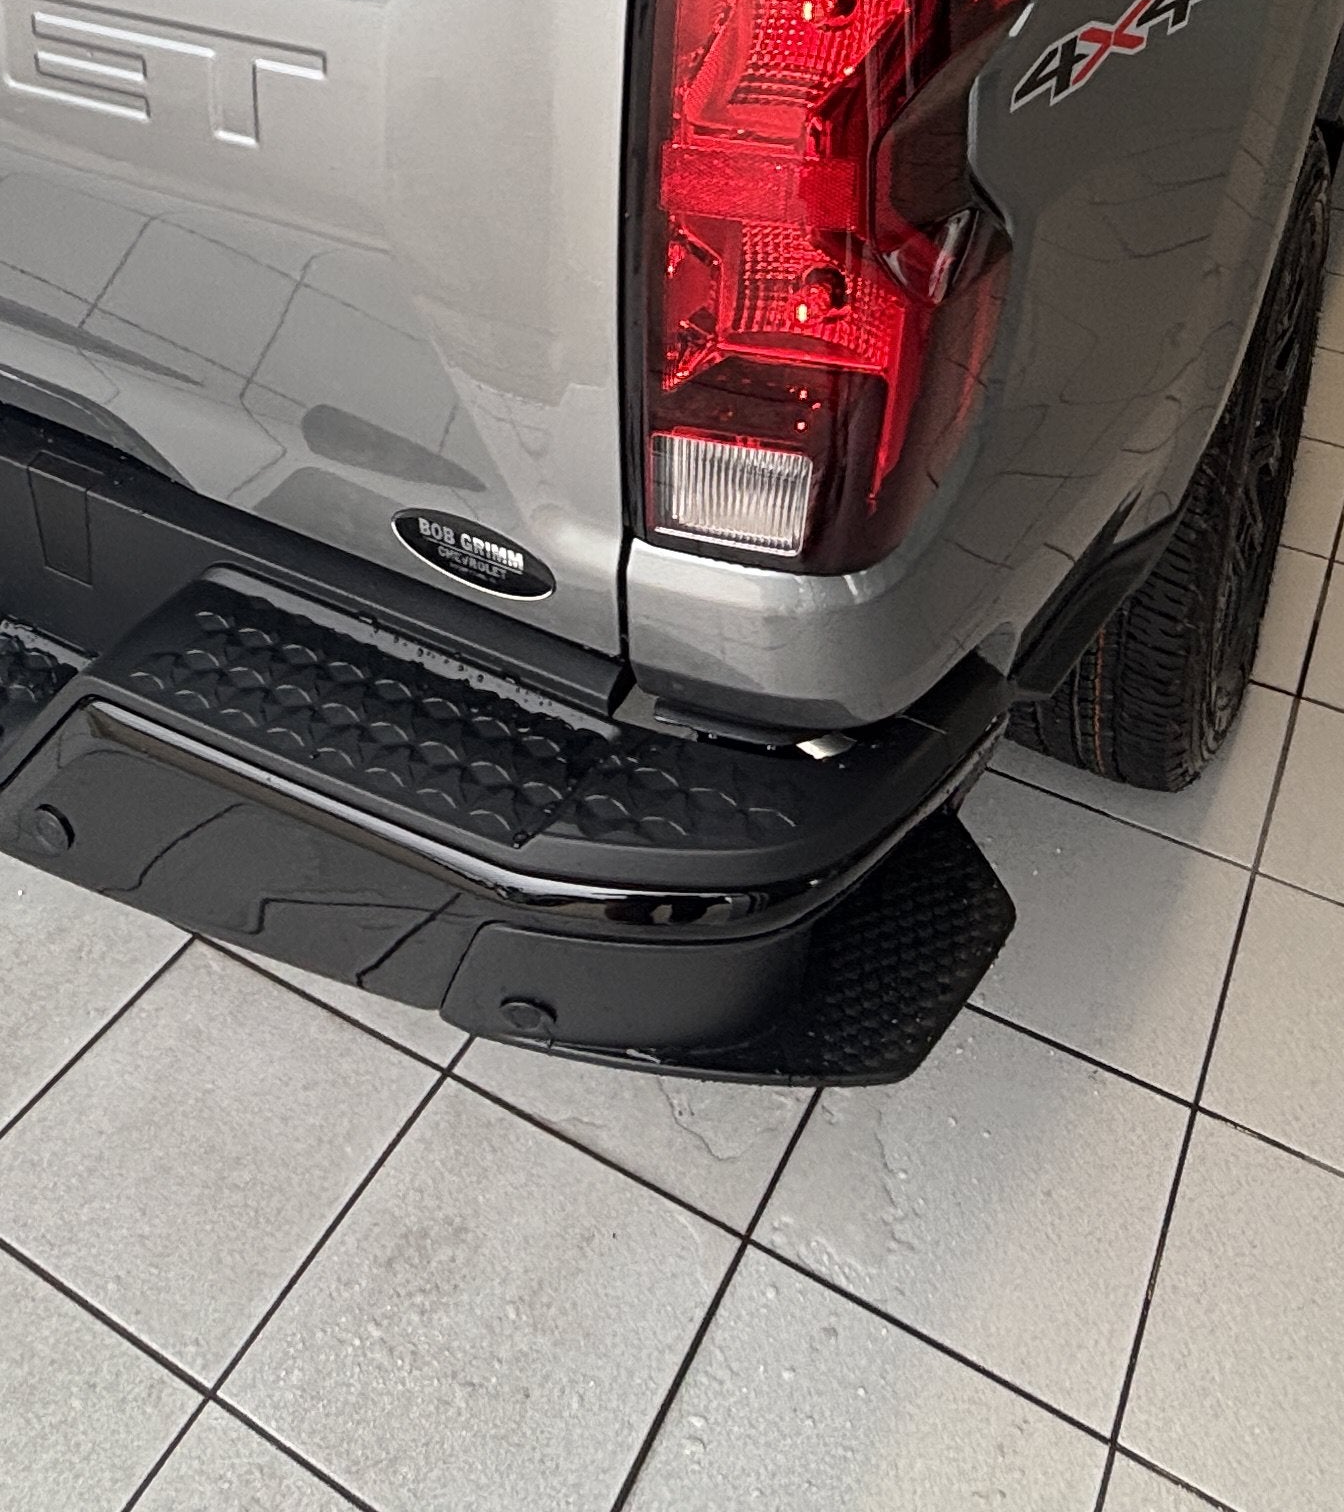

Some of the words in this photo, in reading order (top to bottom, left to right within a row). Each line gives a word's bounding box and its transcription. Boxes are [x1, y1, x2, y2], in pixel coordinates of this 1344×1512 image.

[418, 517, 456, 545] BOB
[460, 533, 524, 571] GRIMM
[437, 545, 507, 580] CHEVROLET
